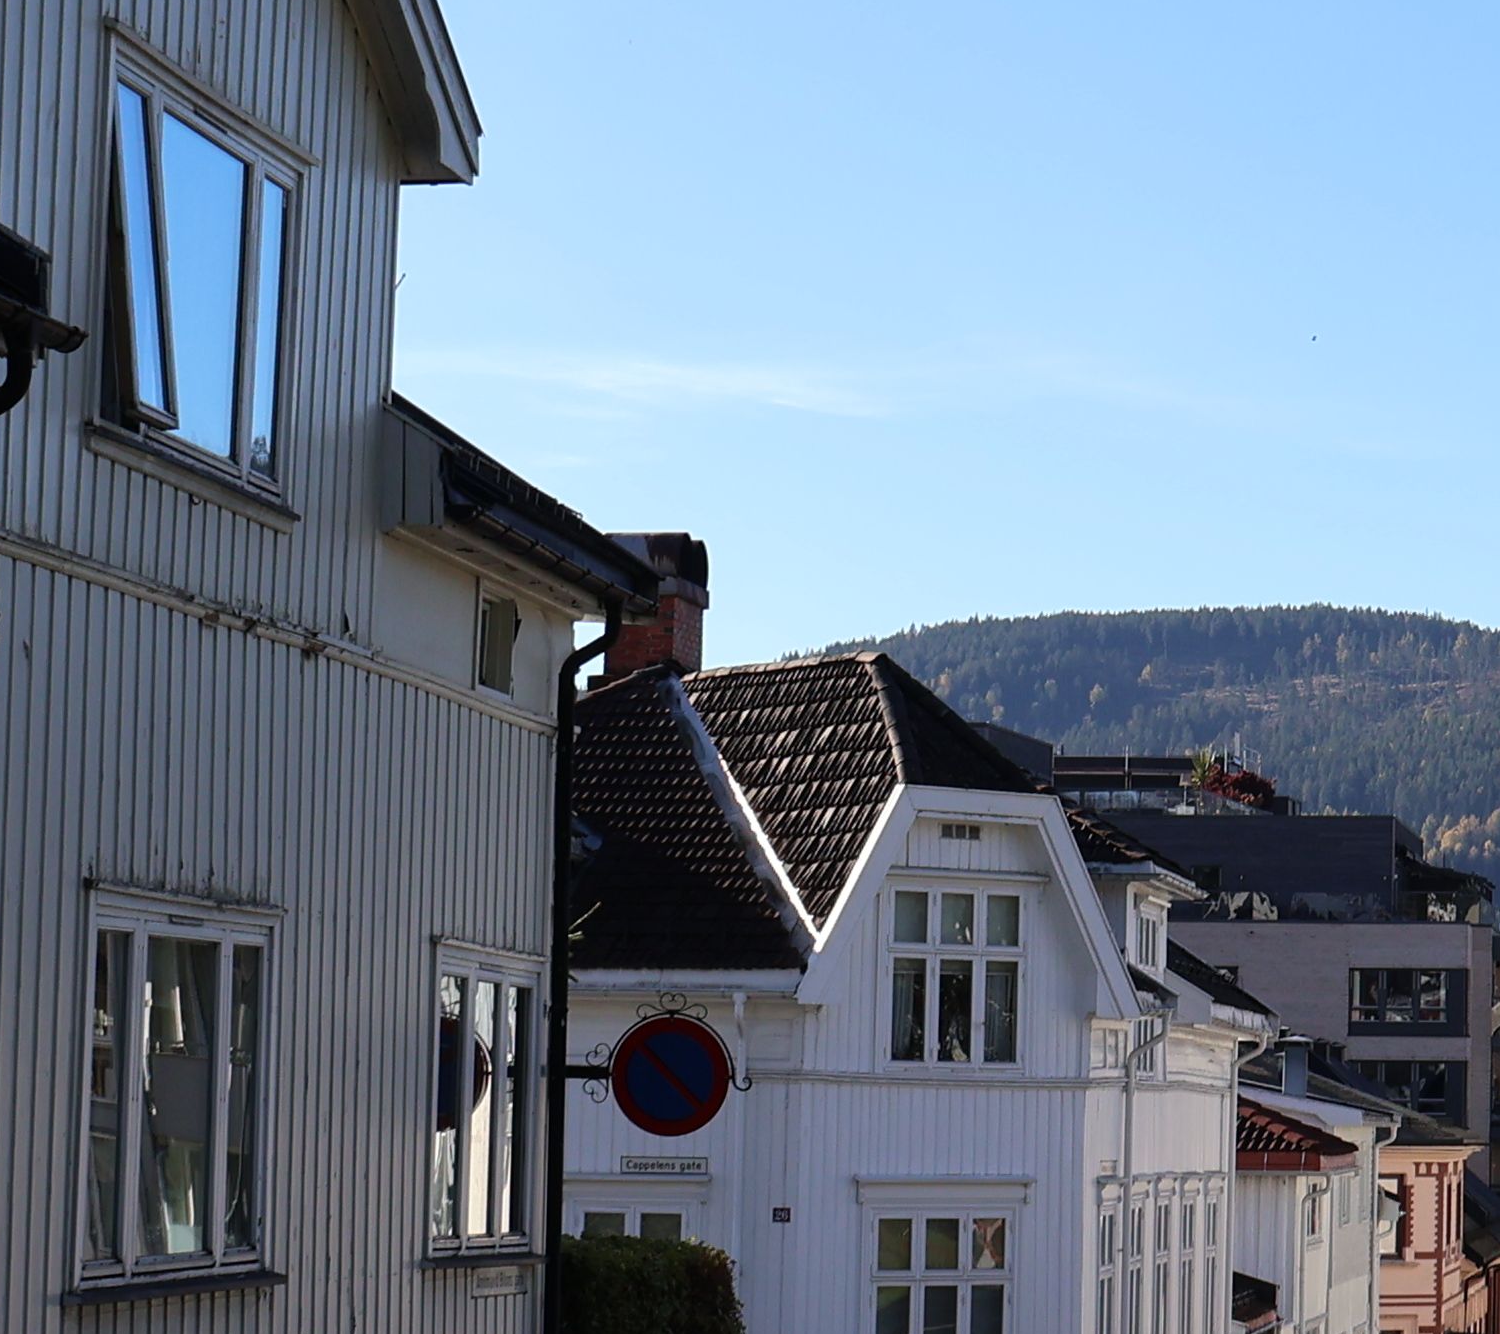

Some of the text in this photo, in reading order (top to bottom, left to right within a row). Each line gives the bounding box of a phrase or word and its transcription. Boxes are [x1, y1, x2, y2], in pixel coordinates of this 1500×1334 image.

[625, 1159, 702, 1172] Cappelens gate
[775, 1210, 788, 1221] 26
